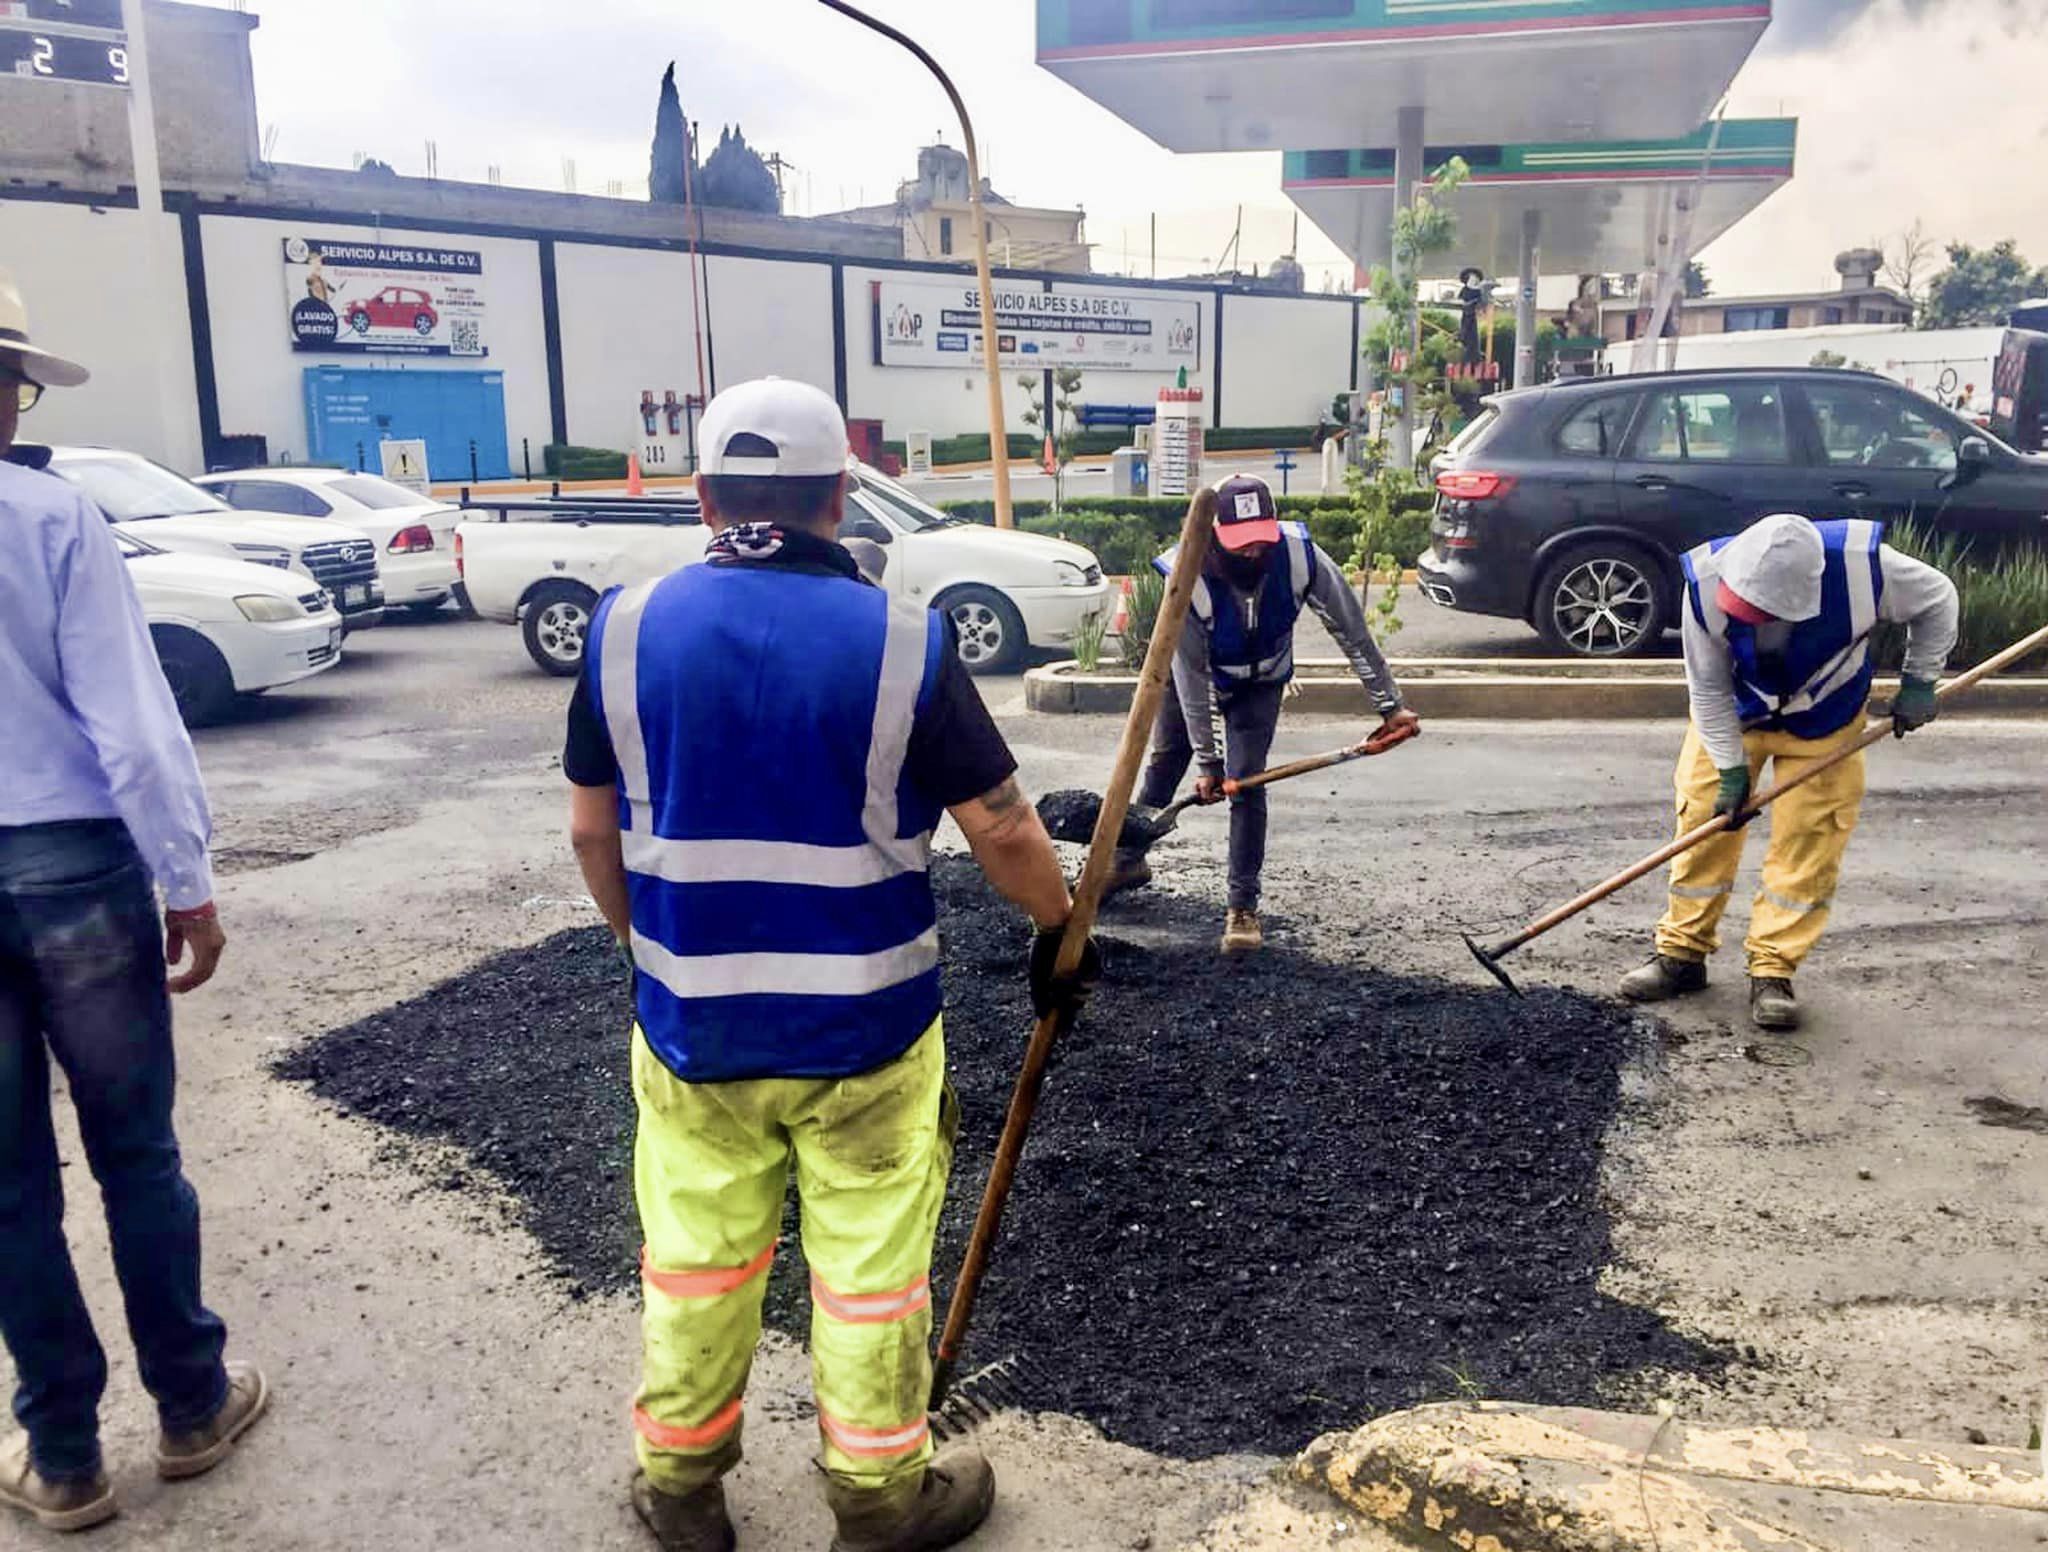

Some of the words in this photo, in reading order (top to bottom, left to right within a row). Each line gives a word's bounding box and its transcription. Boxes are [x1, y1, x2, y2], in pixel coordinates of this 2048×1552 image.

[33, 38, 54, 74] 2
[108, 48, 129, 82] 9
[320, 245, 376, 260] SERVICIO
[378, 250, 414, 264] ALPES
[416, 252, 438, 265] S.A.
[440, 254, 455, 266] DE
[457, 255, 478, 268] C.V.
[964, 291, 1025, 310] SEVICIO
[1028, 296, 1067, 312] ALPES
[1070, 298, 1089, 315] S.A
[1093, 300, 1108, 315] DE
[1111, 301, 1132, 316] C.V.
